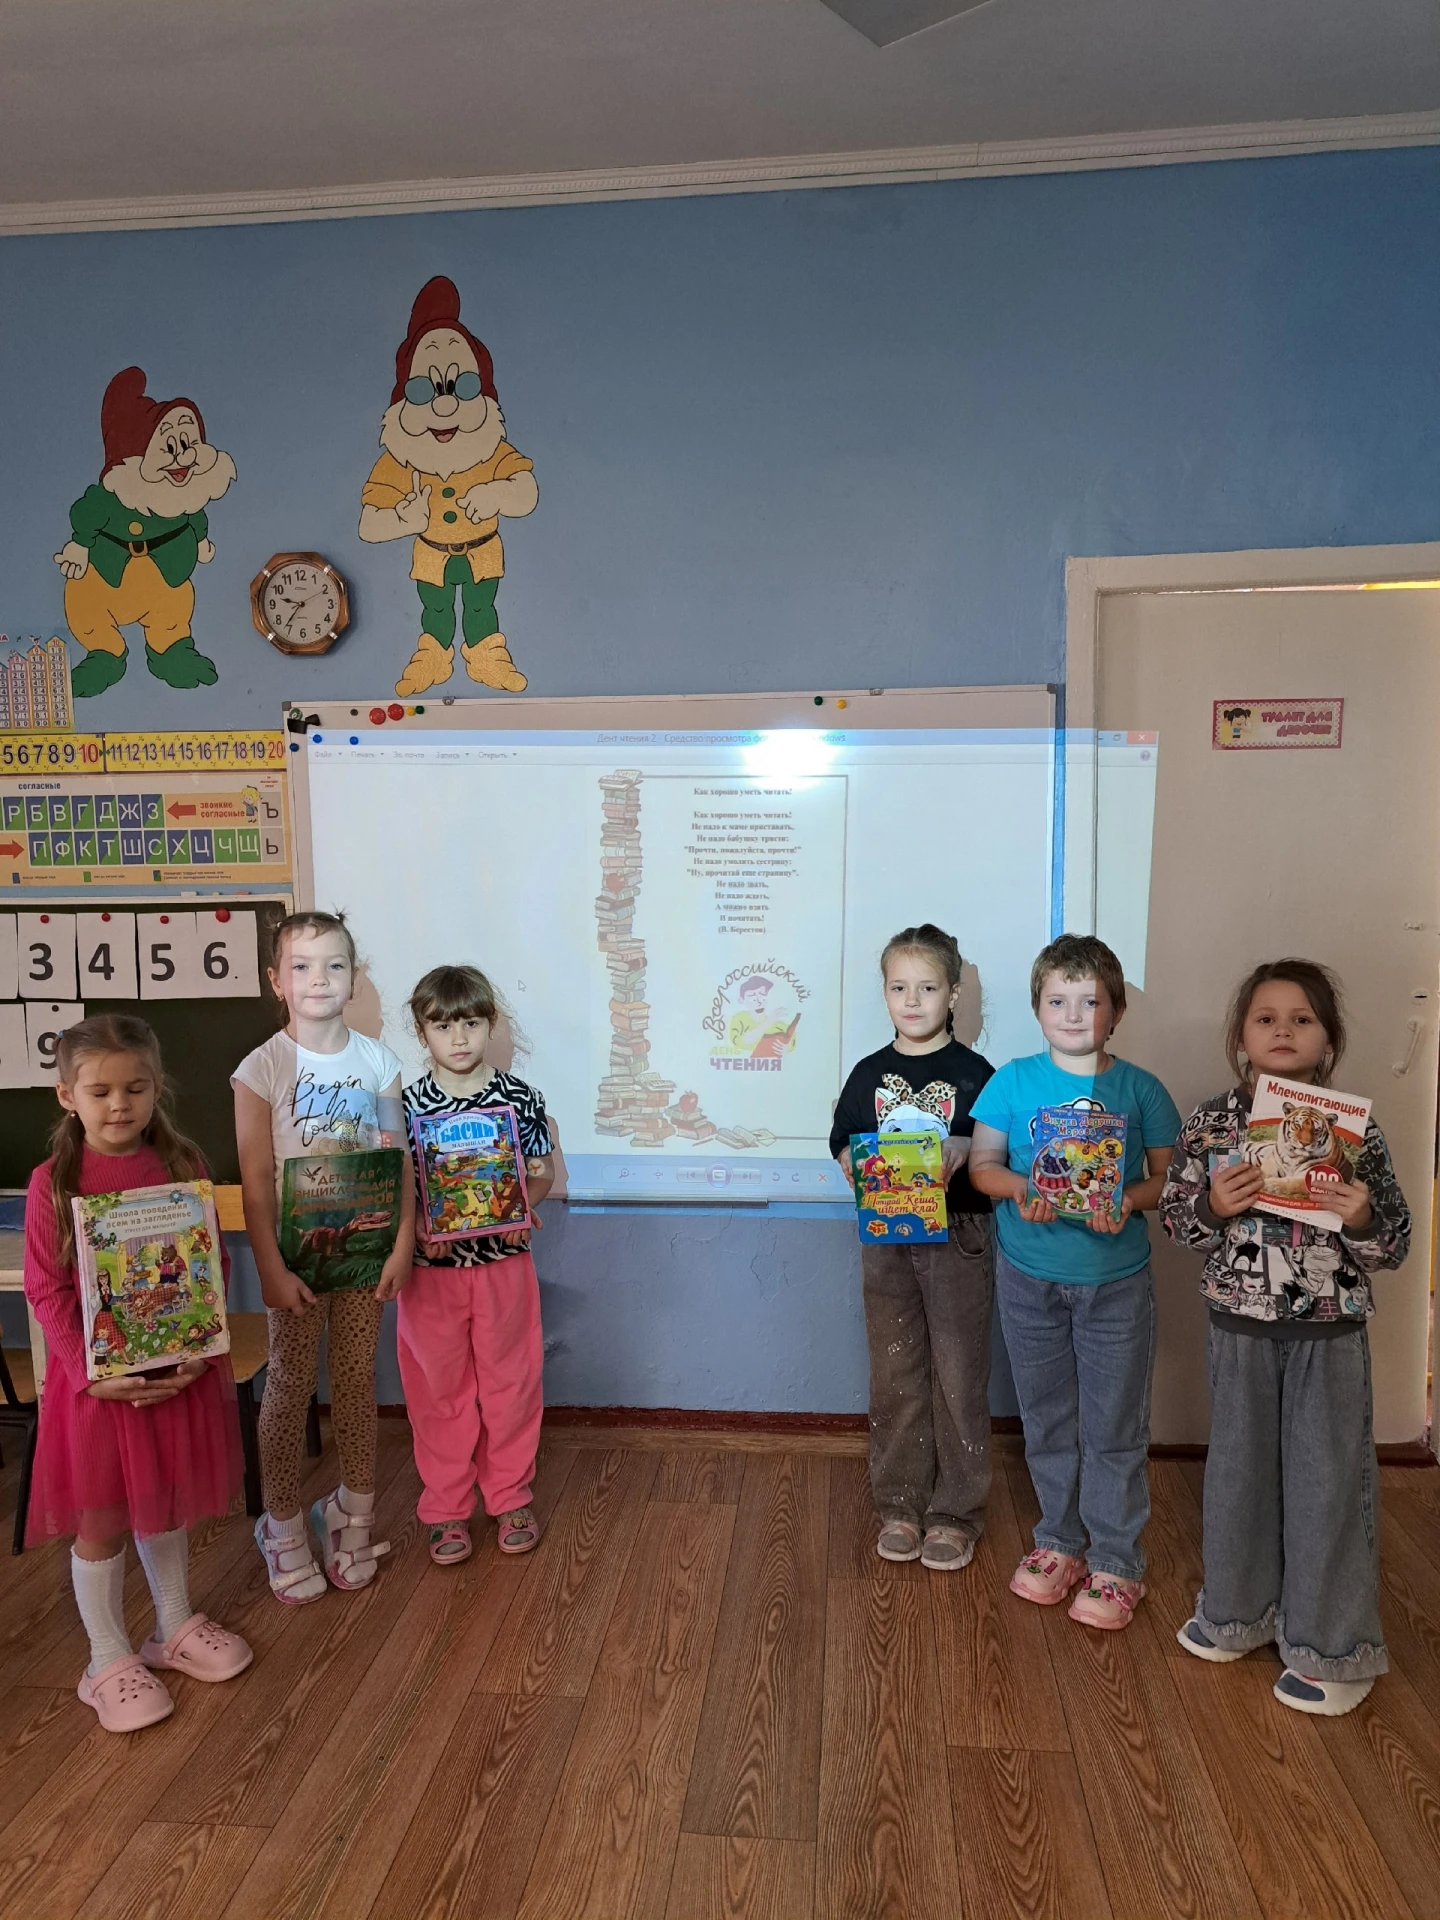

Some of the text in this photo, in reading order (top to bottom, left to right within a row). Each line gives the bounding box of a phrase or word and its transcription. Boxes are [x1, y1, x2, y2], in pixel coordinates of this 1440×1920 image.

[282, 574, 291, 585] 11
[295, 570, 306, 581] 12
[312, 574, 317, 584] 1
[273, 585, 284, 595] 10
[322, 584, 328, 594] 2
[270, 600, 276, 610] 9
[328, 599, 334, 609] 3
[276, 615, 281, 625] 8
[324, 614, 330, 623] 4
[286, 624, 292, 635] 7
[300, 628, 306, 638] 6
[315, 624, 321, 634] 5
[651, 734, 656, 742] 2
[665, 734, 703, 743] Средство
[706, 735, 751, 743] просмотра
[3, 744, 98, 764] 5 6 7 8 9 10
[111, 741, 283, 761] 11 12 13 14 15 16 17 18 19 20
[478, 752, 507, 760] Открыть
[9, 802, 158, 822] Р Б В Г Д Ж З
[262, 802, 278, 818] Ъ
[727, 835, 758, 843] бабушку
[33, 835, 278, 857] П Ф К Т Ш С Х Ц Ч Щ Ь
[29, 943, 53, 980] 3
[88, 943, 115, 980] 4
[151, 943, 175, 981] 5
[702, 958, 811, 1040] Всероссийский
[37, 1032, 58, 1069] 9
[710, 1058, 782, 1071] ЧТЕНИЯ
[288, 1066, 365, 1117] Begin
[1266, 1081, 1367, 1118] Млекопитающие
[904, 1195, 935, 1206] Кеша
[109, 1203, 187, 1219] Школа поведения
[878, 1201, 938, 1215] ищет клад
[144, 1211, 191, 1223] загляденье
